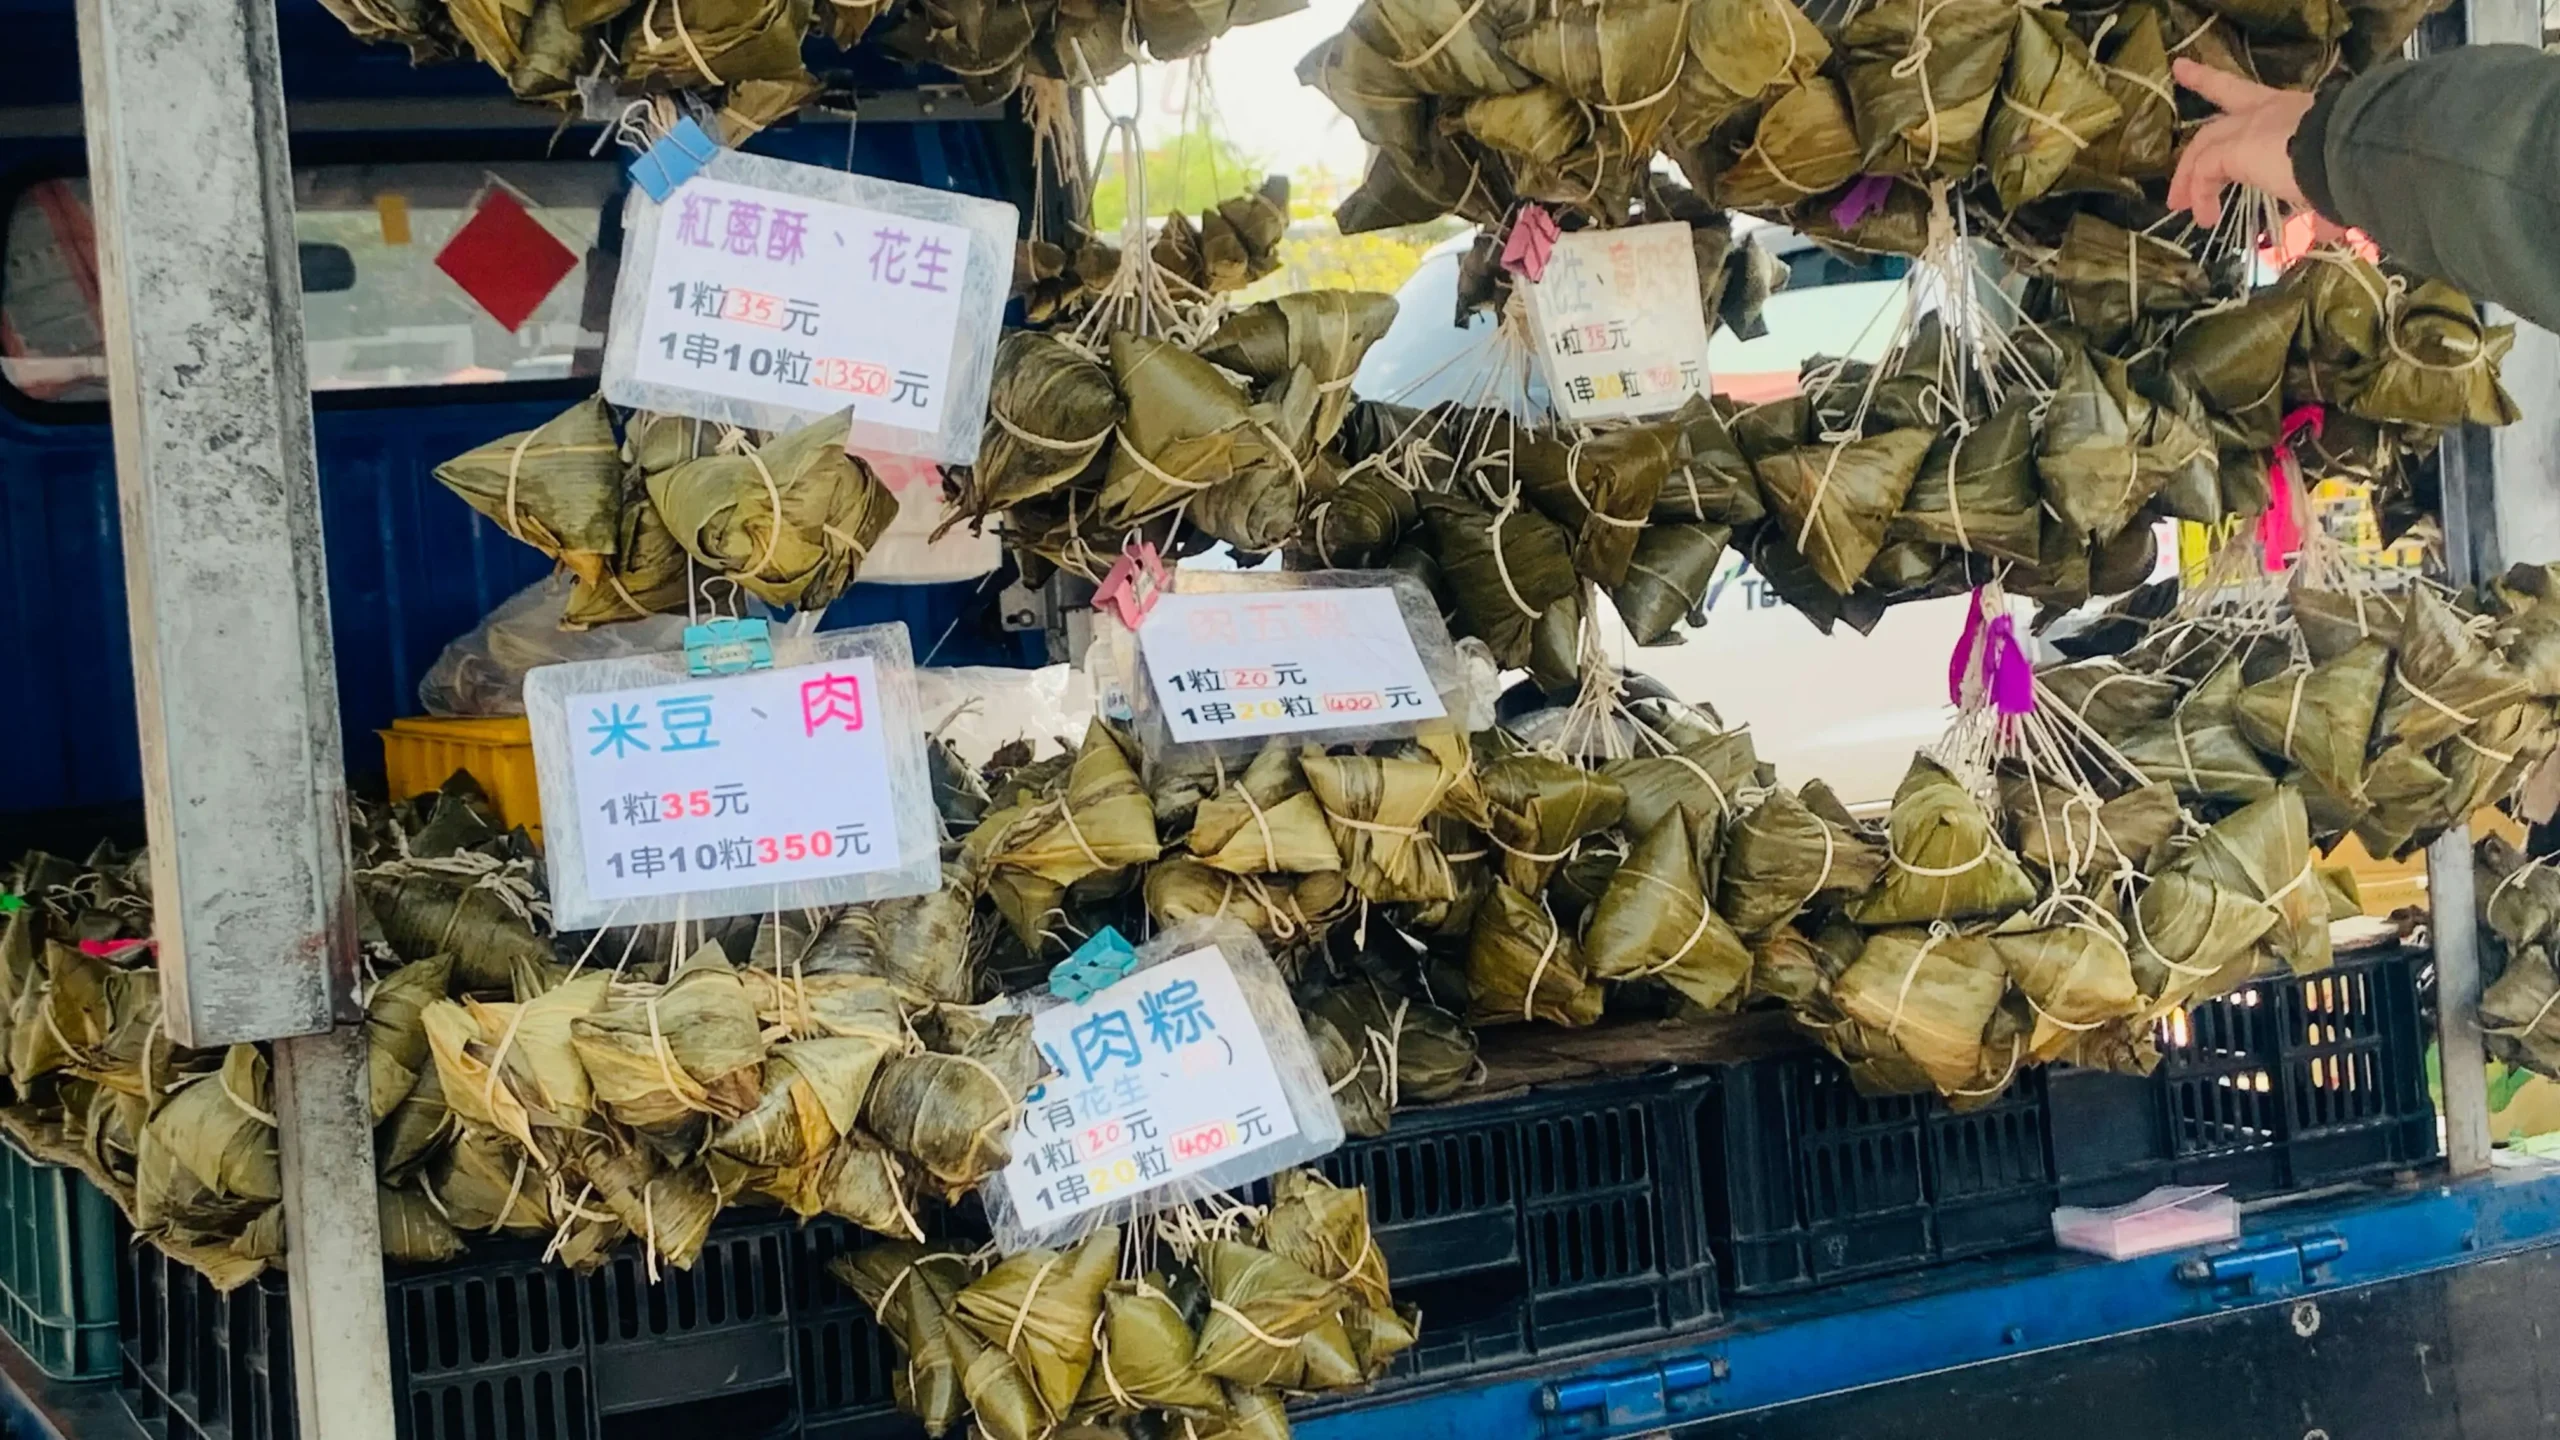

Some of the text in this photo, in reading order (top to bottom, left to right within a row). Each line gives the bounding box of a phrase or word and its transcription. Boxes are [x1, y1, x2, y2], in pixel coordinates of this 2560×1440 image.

[667, 281, 820, 337] 1粒35元
[1169, 662, 1307, 693] 1粒20元
[600, 782, 749, 826] 1粒35元
[607, 823, 870, 879] 1串10粒350元
[1023, 1109, 1158, 1177] 1粒20元
